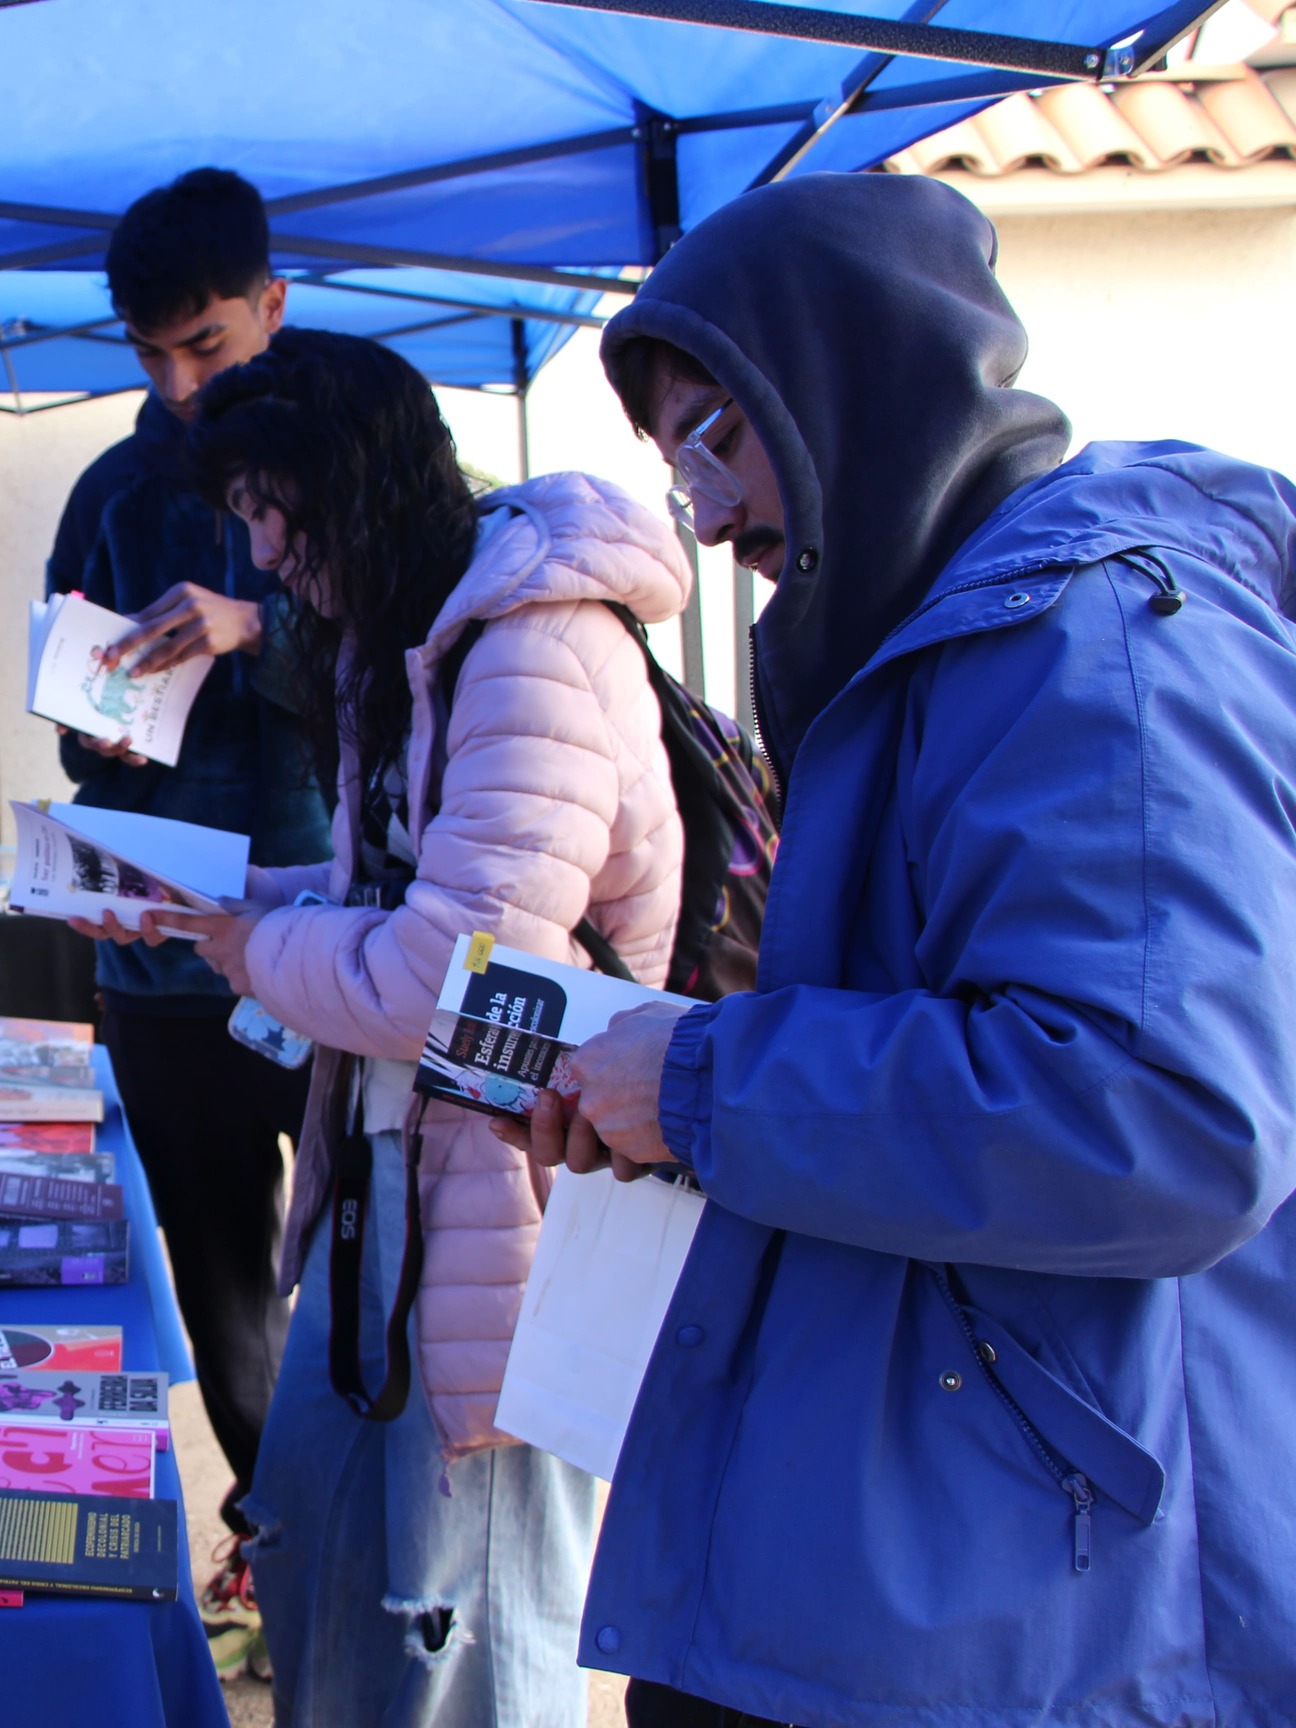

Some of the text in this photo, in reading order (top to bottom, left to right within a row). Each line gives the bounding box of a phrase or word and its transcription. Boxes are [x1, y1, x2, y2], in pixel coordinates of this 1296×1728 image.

[494, 992, 507, 1003] la
[490, 1005, 504, 1024] de
[341, 1198, 358, 1241] EOS
[98, 1375, 128, 1411] FERREIRA
[129, 1378, 158, 1412] DA SILVA
[109, 1513, 120, 1527] DEL
[84, 1511, 97, 1557] ECOFEMINISMO
[96, 1512, 109, 1558] DECOLONIAL
[108, 1527, 119, 1551] CRISIS
[119, 1513, 131, 1560] PATRIARCADO
[31, 1580, 49, 1588] CRISIS
[55, 1583, 90, 1591] DECOLONIAL
[90, 1585, 133, 1594] ECOFEMINISMO
